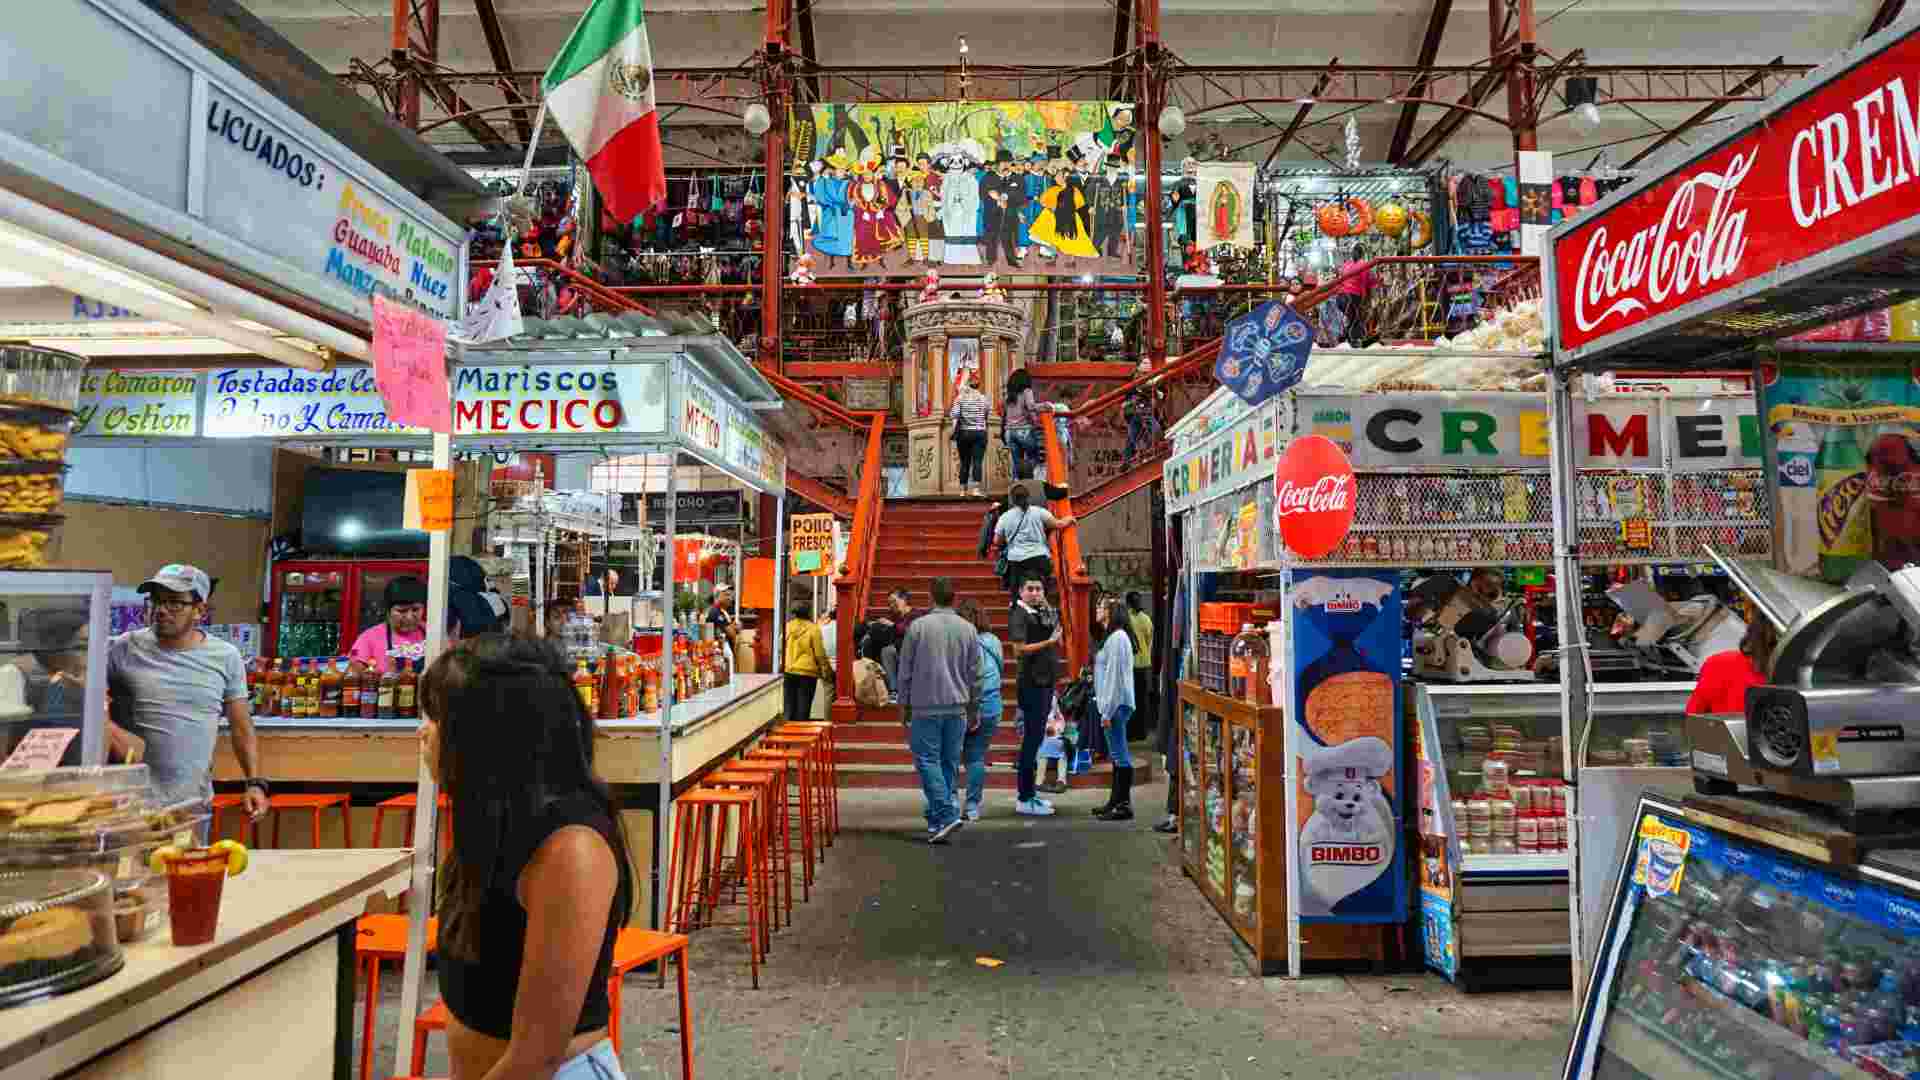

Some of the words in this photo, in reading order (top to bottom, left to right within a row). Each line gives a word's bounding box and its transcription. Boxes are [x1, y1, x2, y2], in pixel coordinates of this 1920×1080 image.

[208, 101, 325, 190] LICUADOS:
[1575, 144, 1760, 332] Coca-Cola
[335, 219, 400, 277] Guayaba
[411, 260, 449, 300] Nuez
[217, 367, 317, 393] Tostadas
[320, 367, 347, 393] de
[457, 367, 618, 392] Mariscos
[294, 402, 321, 432] Y
[455, 399, 623, 430] MECICO
[1278, 474, 1351, 517] Coca-Cola
[793, 535, 832, 551] FRESCO
[1311, 846, 1380, 862] BIMBO
